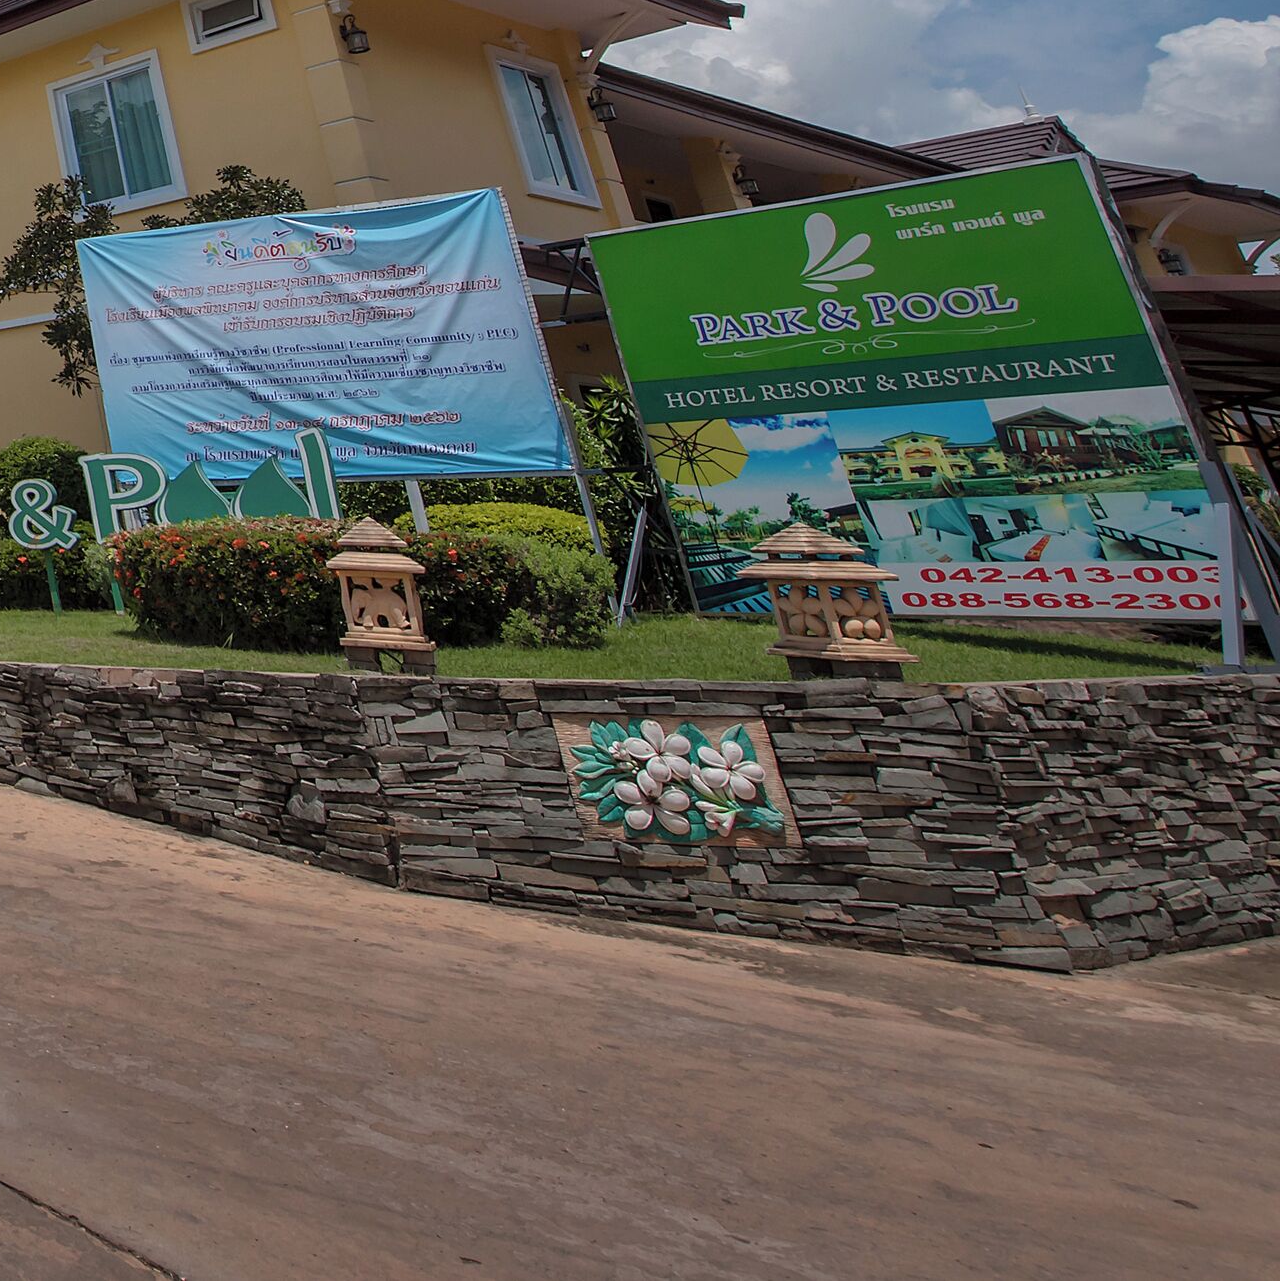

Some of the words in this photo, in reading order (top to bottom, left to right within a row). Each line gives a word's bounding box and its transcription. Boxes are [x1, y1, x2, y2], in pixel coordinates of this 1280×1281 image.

[885, 199, 956, 218] โรงแรม
[952, 211, 1007, 232] แอนด์
[1012, 209, 1046, 226] พูล
[221, 229, 342, 262] ยินดีต้อนรับ
[153, 285, 202, 303] ผู้บริหาร
[691, 308, 814, 345] PARK
[817, 299, 861, 331] &
[863, 284, 1018, 326] POOL
[348, 336, 402, 350] Learning
[405, 331, 473, 346] Community
[665, 385, 756, 408] HOTEL
[760, 375, 867, 400] RESORT
[876, 374, 898, 392] &
[901, 353, 1116, 389] RESTAURANT
[9, 478, 81, 550] &
